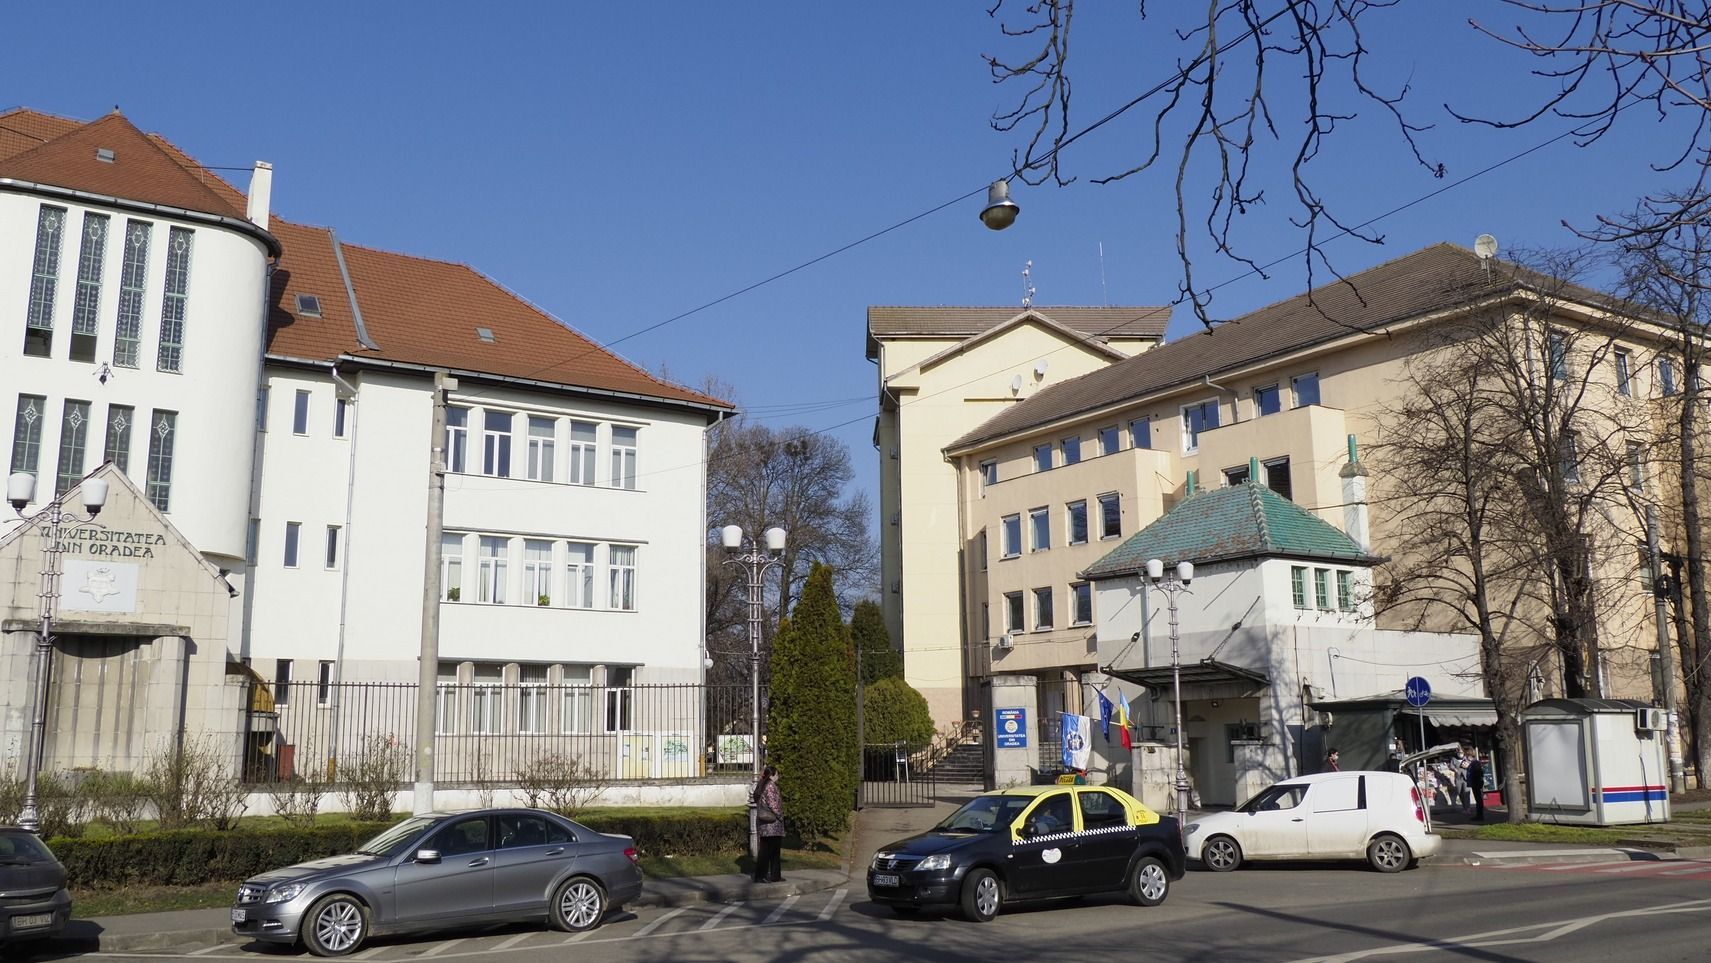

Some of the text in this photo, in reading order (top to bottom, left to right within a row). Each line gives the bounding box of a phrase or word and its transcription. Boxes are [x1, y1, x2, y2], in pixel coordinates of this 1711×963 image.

[41, 526, 167, 545] UNIVERSITATEA
[56, 541, 154, 558] DIN ORADEA
